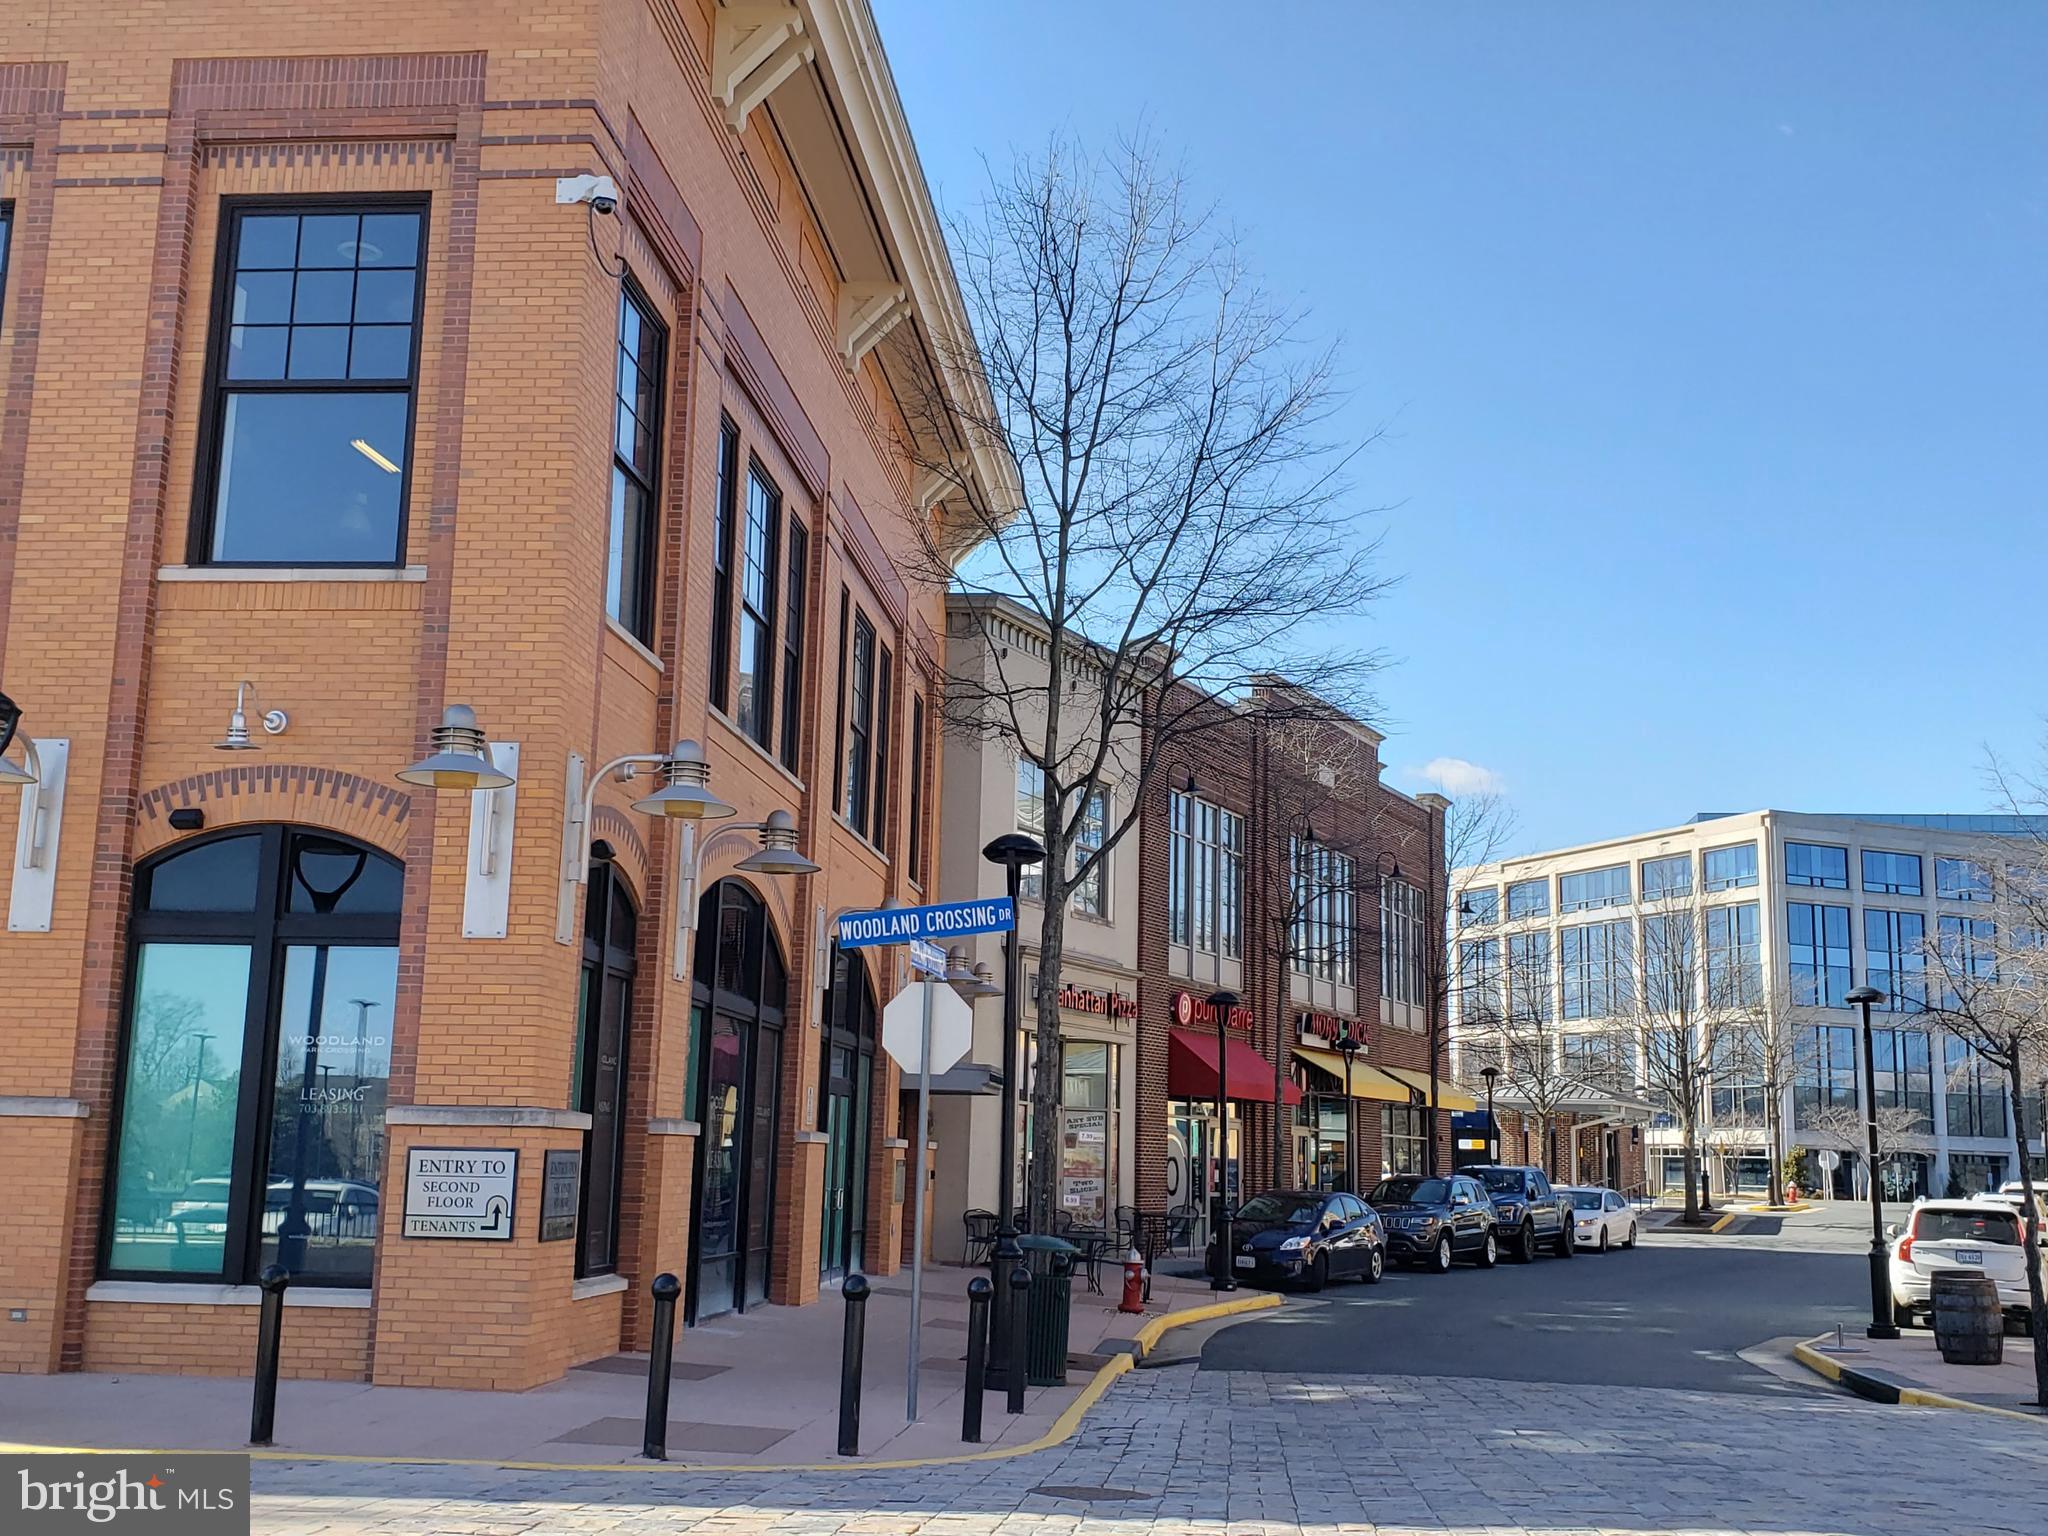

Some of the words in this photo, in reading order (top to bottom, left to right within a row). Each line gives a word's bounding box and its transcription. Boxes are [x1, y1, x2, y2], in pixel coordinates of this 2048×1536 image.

[840, 914, 920, 941] WOODLAND
[926, 905, 996, 932] CROSSING
[999, 908, 1012, 921] DR
[1058, 985, 1108, 1014] anhattan
[1111, 992, 1138, 1018] Pizza
[1311, 1013, 1339, 1041] MOBY
[1348, 1021, 1370, 1044] DICK
[288, 1035, 386, 1046] WOODLAND
[301, 1087, 364, 1101] LEASING
[1068, 1121, 1103, 1130] SPECIAL
[418, 1159, 478, 1174] ENTRY
[481, 1160, 506, 1175] TO
[422, 1181, 480, 1193] SECOND
[427, 1196, 474, 1209] FLOOR
[411, 1219, 476, 1232] TENANTS
